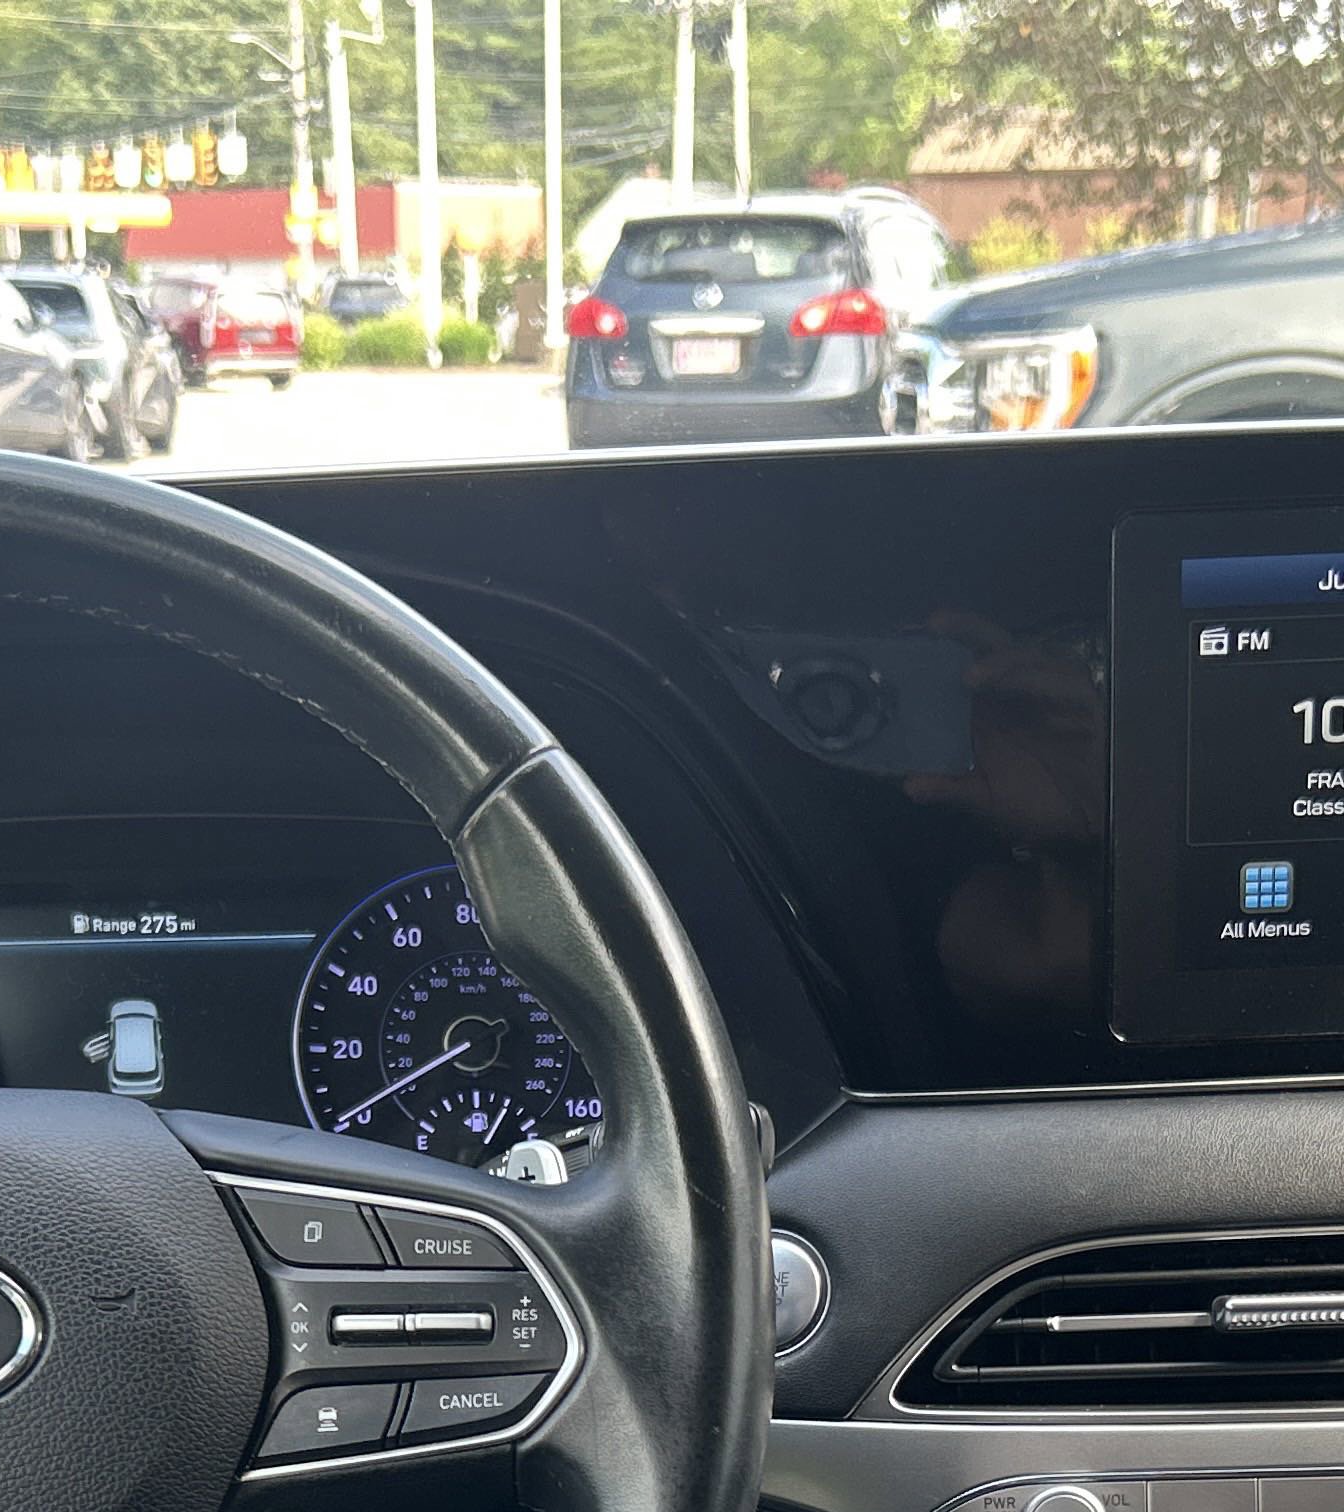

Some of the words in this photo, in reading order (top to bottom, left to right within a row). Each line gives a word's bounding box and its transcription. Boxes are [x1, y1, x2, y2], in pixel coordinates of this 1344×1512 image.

[1237, 629, 1271, 652] FM
[93, 918, 137, 934] Range
[140, 914, 178, 935] 275
[180, 918, 196, 932] mi
[1220, 920, 1245, 939] All
[1248, 918, 1310, 938] Menus
[393, 928, 422, 947] 60
[451, 966, 470, 977] 120
[478, 965, 496, 977] 140
[348, 976, 378, 996] 40
[429, 977, 448, 989] 100
[459, 983, 487, 995] km/h
[414, 991, 429, 1002] 80
[401, 1010, 416, 1021] 60
[529, 1011, 549, 1022] 200
[396, 1033, 410, 1044] 40
[536, 1033, 555, 1044] 220
[333, 1039, 363, 1059] 20
[398, 1057, 413, 1069] 20
[534, 1057, 554, 1069] 240
[525, 1080, 546, 1091] 260
[566, 1099, 602, 1118] 160
[417, 1135, 428, 1150] E
[414, 1239, 473, 1255] CRUISE
[512, 1309, 538, 1322] RES
[291, 1321, 309, 1334] OK
[512, 1327, 538, 1340] SET
[439, 1392, 503, 1410] CANCEL
[983, 1497, 1016, 1510] PWR
